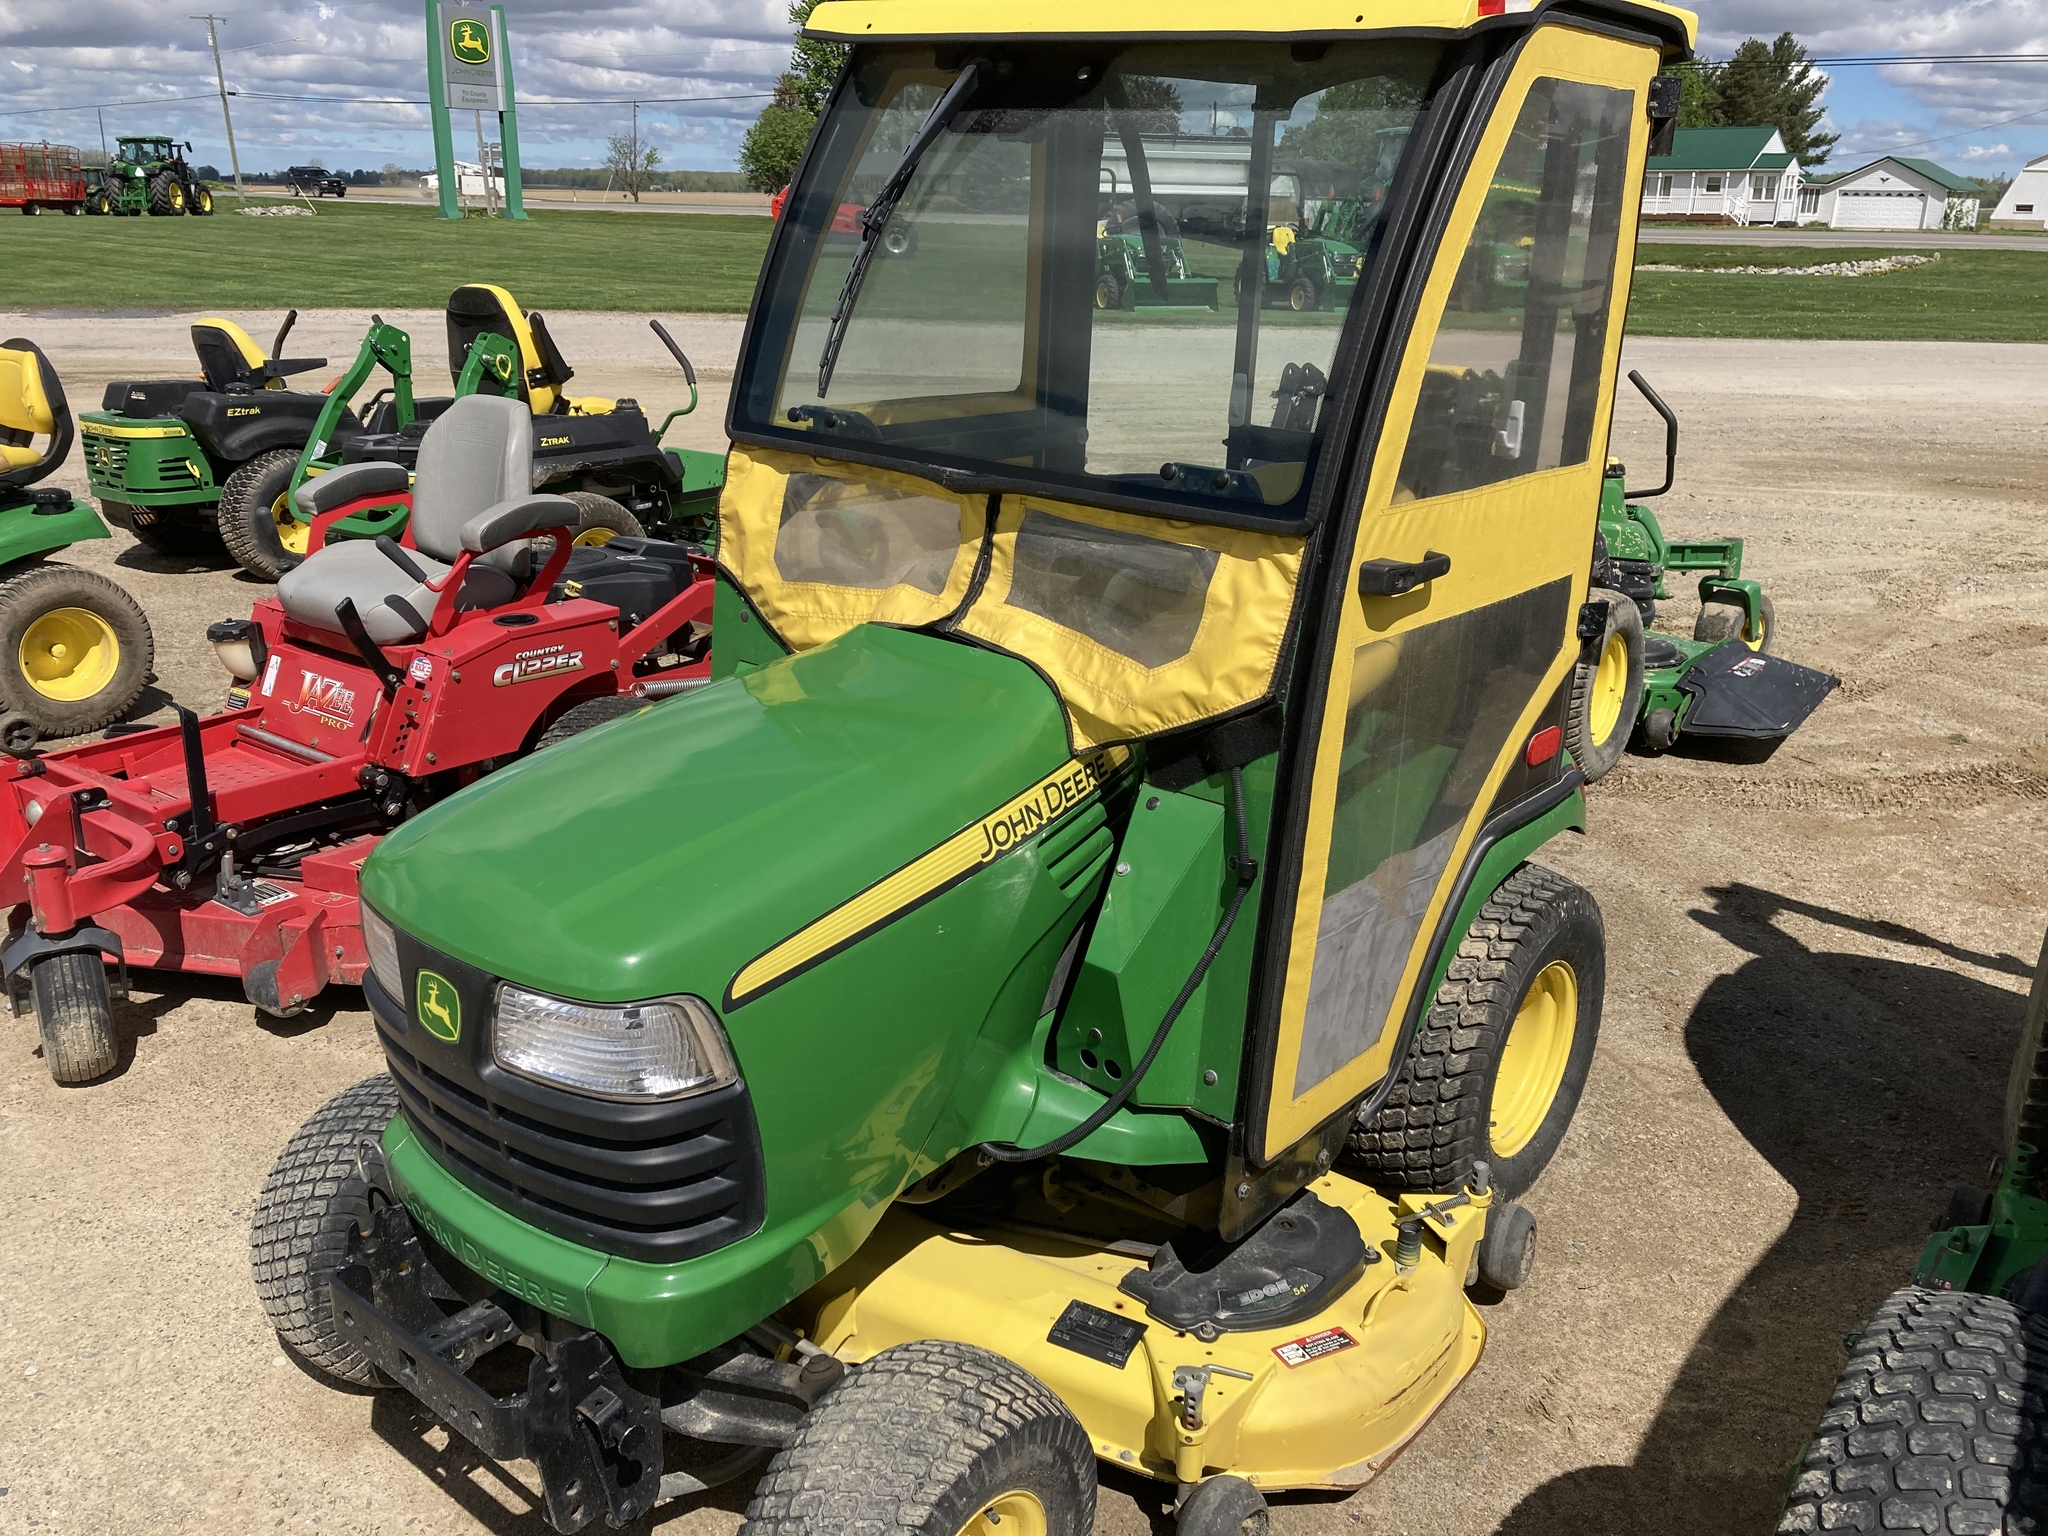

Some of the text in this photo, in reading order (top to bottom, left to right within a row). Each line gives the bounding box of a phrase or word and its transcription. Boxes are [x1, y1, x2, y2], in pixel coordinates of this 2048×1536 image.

[451, 67, 494, 77] JOHN DEERE
[461, 96, 488, 104] Equipment
[469, 90, 487, 98] County
[227, 406, 261, 417] EZtrak
[540, 436, 570, 447] ZTRAK
[515, 644, 565, 660] COUNTRY
[493, 650, 586, 687] CLIPPER
[319, 716, 348, 731] PRO
[980, 753, 1108, 860] JOHN DEERE
[404, 1184, 571, 1317] JOHN DEERE
[1292, 1283, 1309, 1296] 54"
[1309, 1330, 1333, 1341] DANGER
